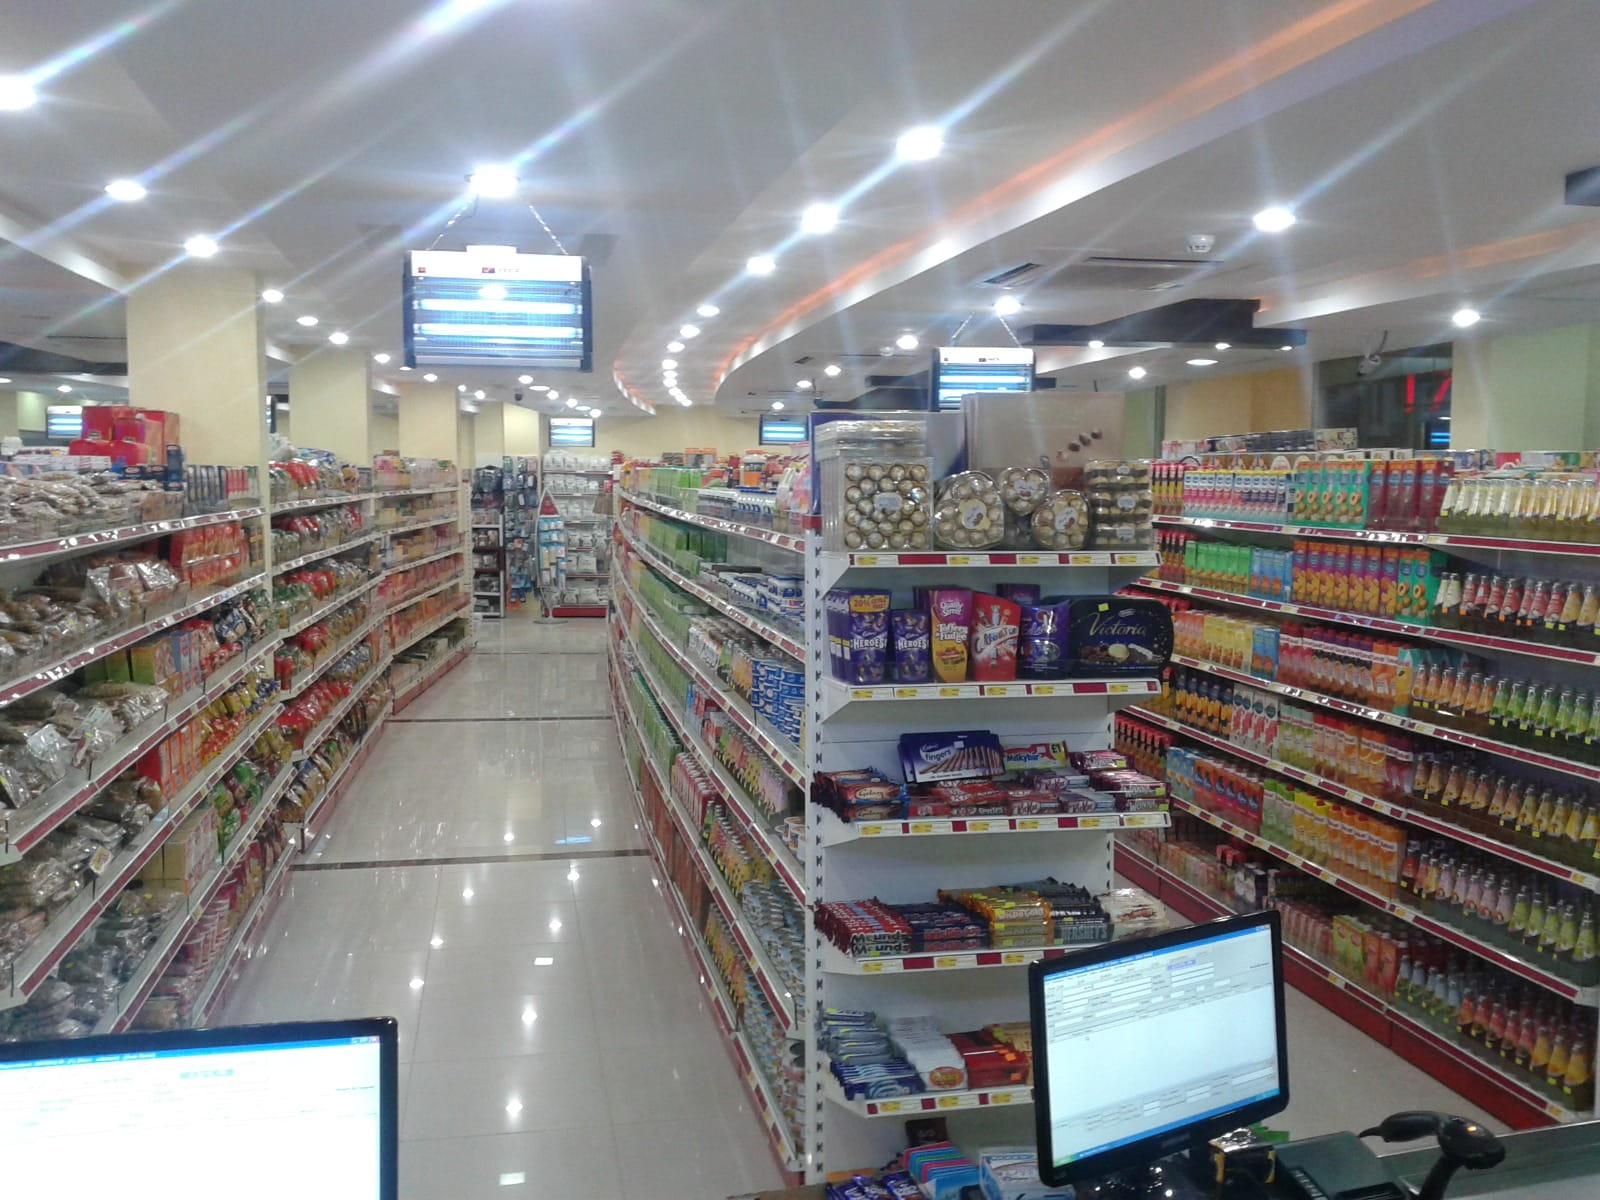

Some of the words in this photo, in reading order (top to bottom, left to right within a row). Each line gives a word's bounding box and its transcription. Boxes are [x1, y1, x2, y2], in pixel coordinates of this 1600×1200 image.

[1089, 612, 1147, 636] Victoria
[853, 639, 884, 649] HEROES
[898, 640, 927, 649] HEROES
[925, 748, 952, 761] fingers
